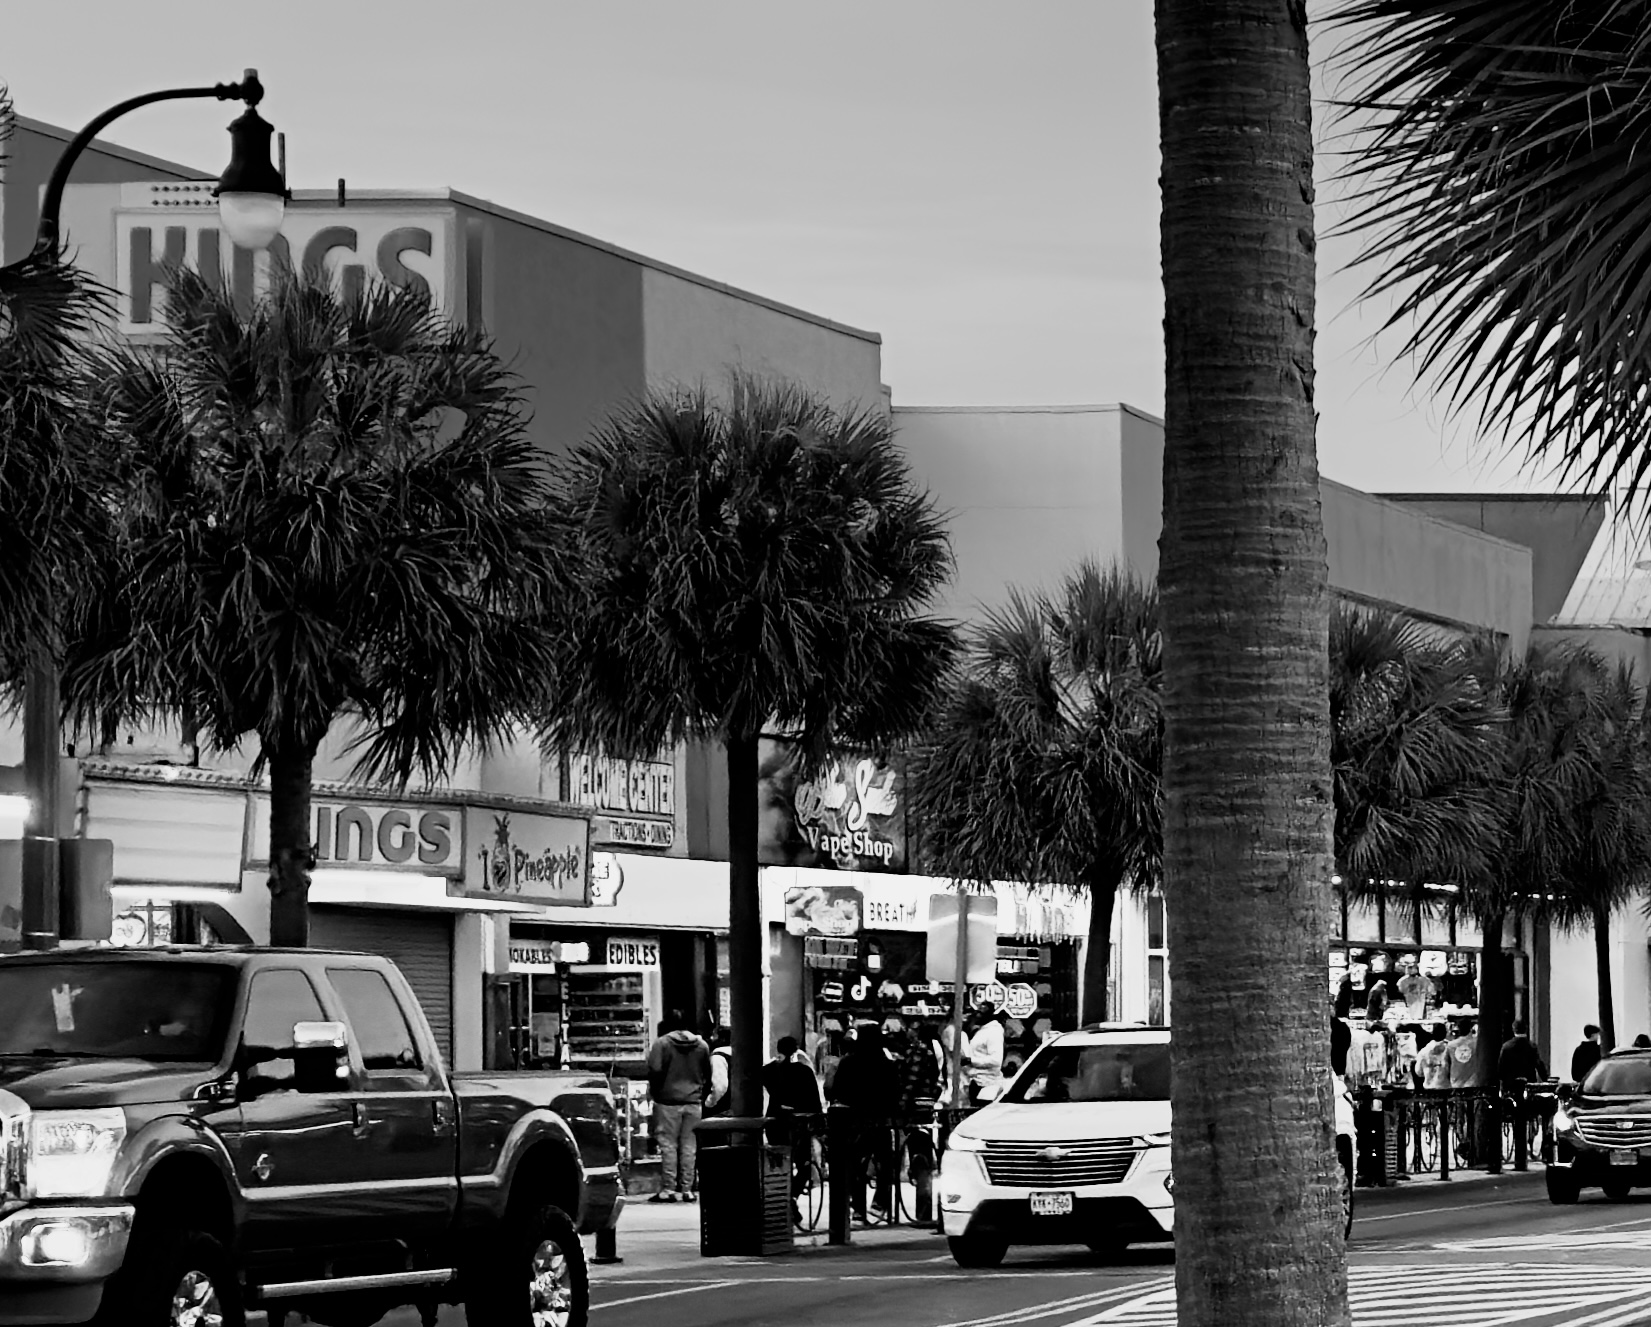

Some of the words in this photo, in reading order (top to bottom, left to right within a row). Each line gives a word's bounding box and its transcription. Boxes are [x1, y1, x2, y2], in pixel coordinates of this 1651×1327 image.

[317, 805, 450, 864] INGS
[794, 818, 853, 860] Vape
[853, 831, 893, 866] Shop
[609, 942, 657, 966] EDIBLES
